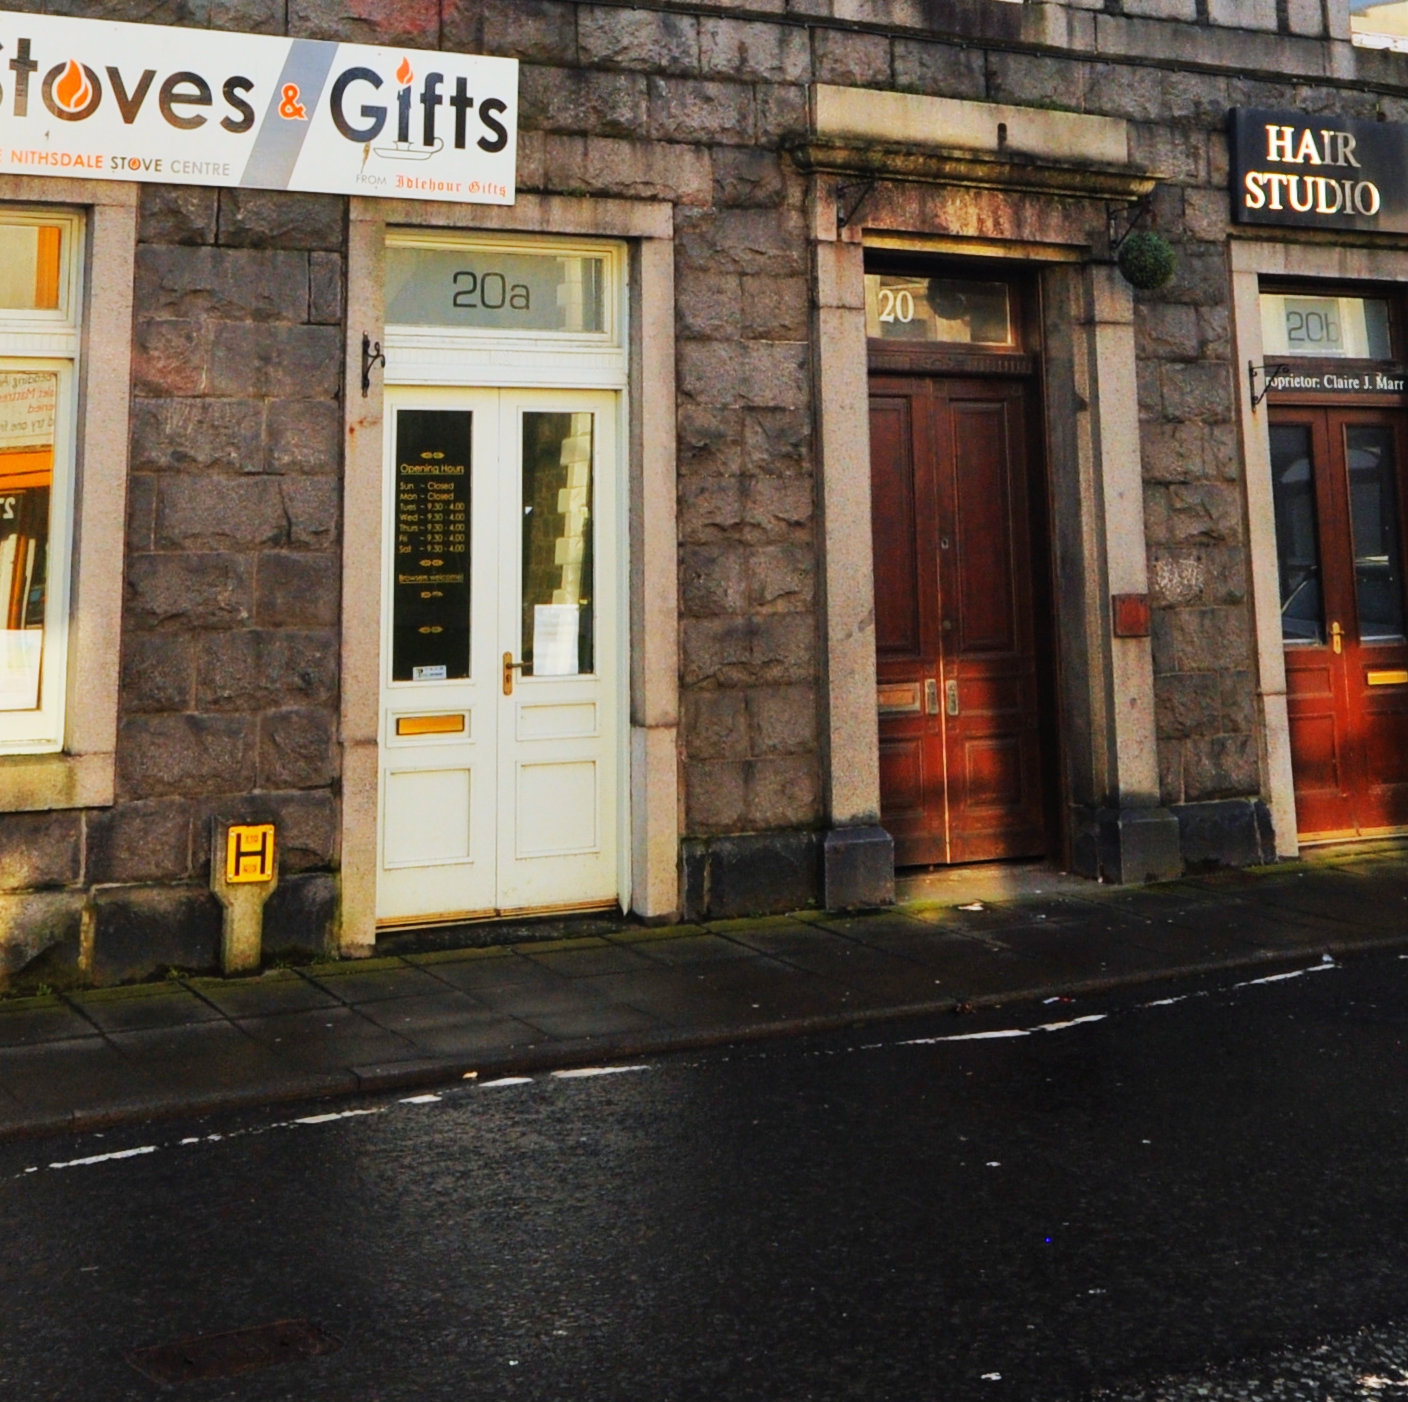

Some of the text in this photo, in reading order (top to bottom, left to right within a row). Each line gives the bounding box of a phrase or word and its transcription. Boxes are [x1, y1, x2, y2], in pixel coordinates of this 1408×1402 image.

[278, 82, 309, 121] &
[330, 60, 508, 153] Gifts
[1265, 124, 1361, 168] HAIR
[10, 150, 103, 169] NITHSDALE
[110, 155, 162, 173] STOVE
[170, 160, 230, 177] CENTRE
[356, 173, 507, 198] FROM Idlehour Gifts
[1245, 171, 1381, 216] STUDIO
[453, 271, 530, 310] 20a
[878, 289, 915, 323] 20
[1286, 311, 1340, 343] 20b
[1265, 372, 1321, 389] roprietor:
[1323, 374, 1360, 389] Claire
[1363, 377, 1373, 390] J.
[400, 463, 439, 474] Opening
[399, 482, 414, 491] Sun
[427, 481, 455, 490] Closed
[399, 492, 418, 501] Mon
[427, 492, 455, 501] Closed
[399, 503, 417, 512] Tues
[399, 513, 419, 522] Wed
[399, 524, 419, 533] Thurs
[399, 535, 408, 544] Fri
[399, 545, 412, 554] Sat
[234, 831, 268, 876] H
